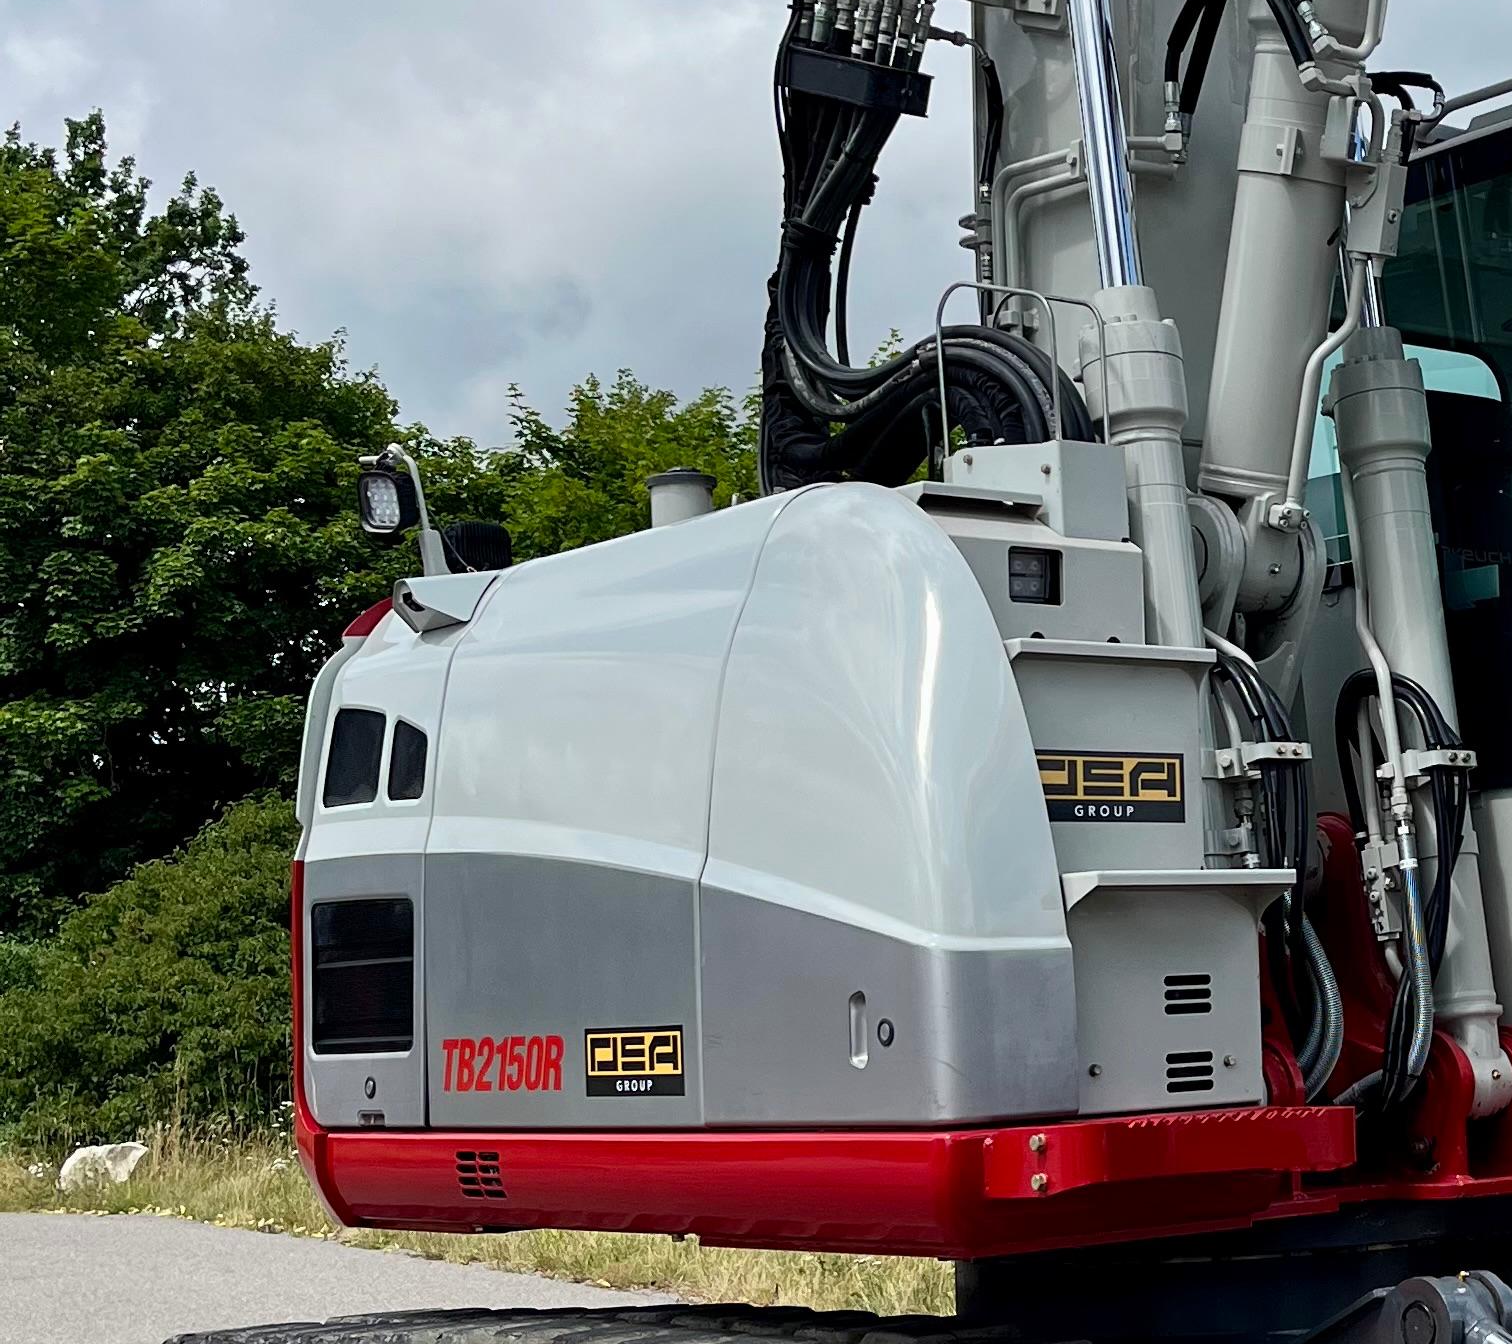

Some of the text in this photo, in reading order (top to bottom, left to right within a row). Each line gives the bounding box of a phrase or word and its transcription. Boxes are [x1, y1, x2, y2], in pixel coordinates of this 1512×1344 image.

[1074, 805, 1134, 817] GROUP
[442, 1035, 564, 1092] TB2150R
[616, 1080, 653, 1091] GROUP
